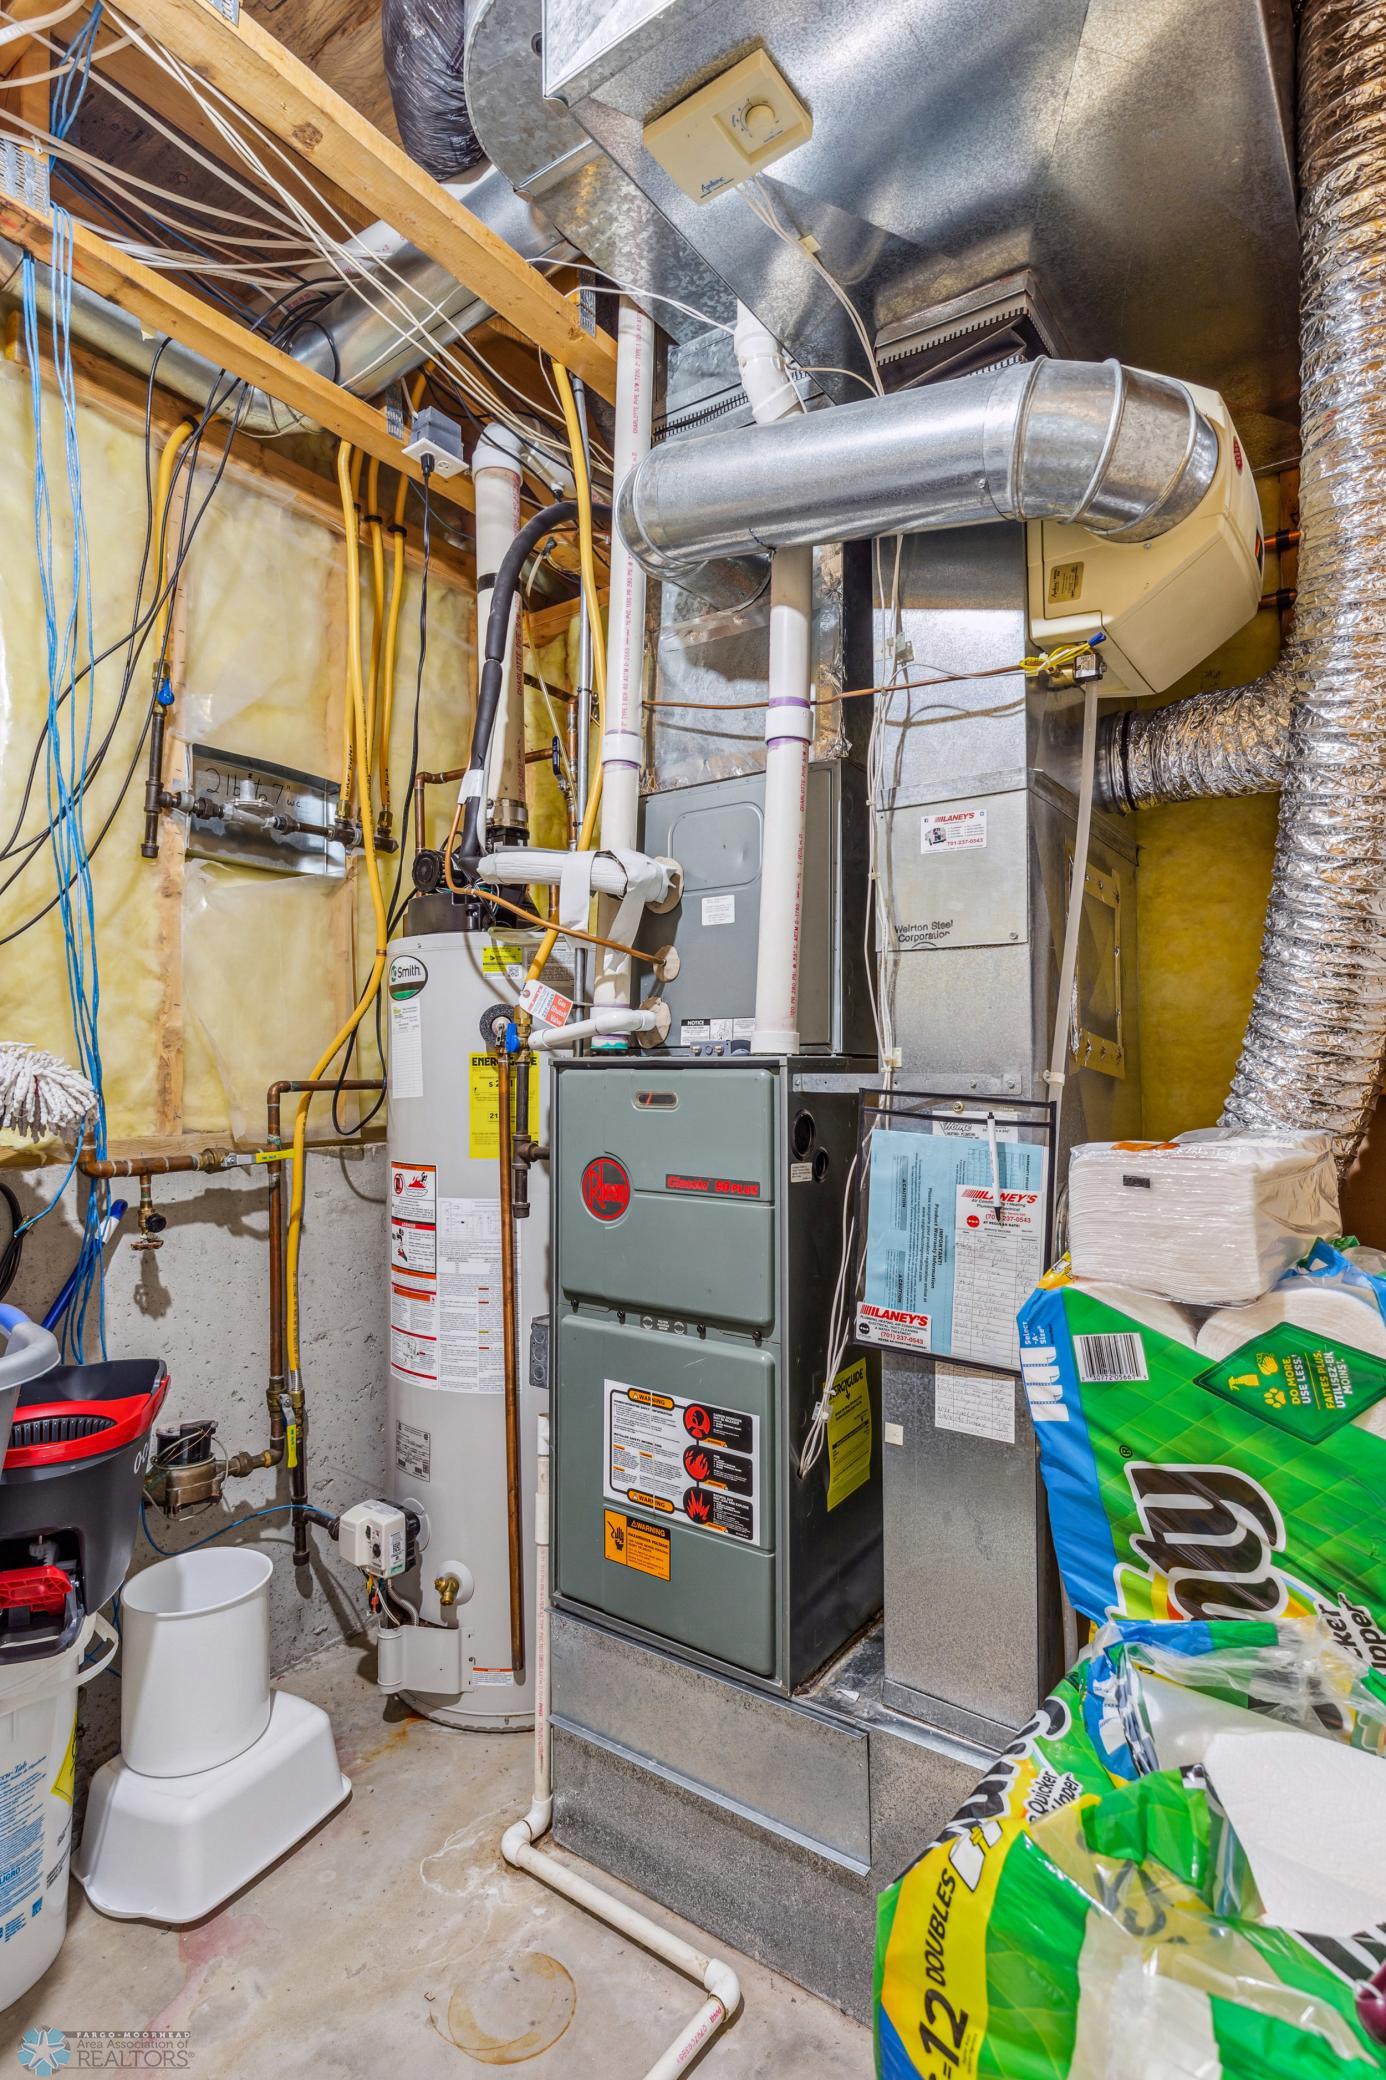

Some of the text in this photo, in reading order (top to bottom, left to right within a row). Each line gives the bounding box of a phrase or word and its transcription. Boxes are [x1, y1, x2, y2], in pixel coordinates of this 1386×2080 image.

[632, 406, 640, 434] CHARLOTTE
[514, 631, 522, 649] PIPE
[514, 650, 523, 696] CHARLOTTE
[941, 812, 975, 823] LANEY'S
[931, 919, 954, 930] Steel
[898, 931, 951, 943] Corporation
[397, 965, 420, 978] Smith
[790, 995, 796, 1005] PR
[588, 1161, 627, 1210] Rheem
[731, 1184, 759, 1196] PLUS
[983, 1189, 1038, 1204] LNEY'S
[1002, 1215, 1031, 1223] 237-0543
[931, 1227, 939, 1254] Warranty
[872, 1306, 928, 1327] LANEY'S
[880, 1331, 924, 1345] (701) 237-0543
[1282, 1356, 1301, 1405] DO MORE.
[1314, 1350, 1335, 1409] FAITES PLUS.
[1324, 1351, 1347, 1408] UTILISEZ-EN
[639, 1394, 666, 1406] WARNING
[1298, 1384, 1312, 1404] USE
[637, 1522, 666, 1537] WARNING
[1033, 1772, 1058, 1815] Quicker
[922, 1869, 957, 1989] DOUBLES
